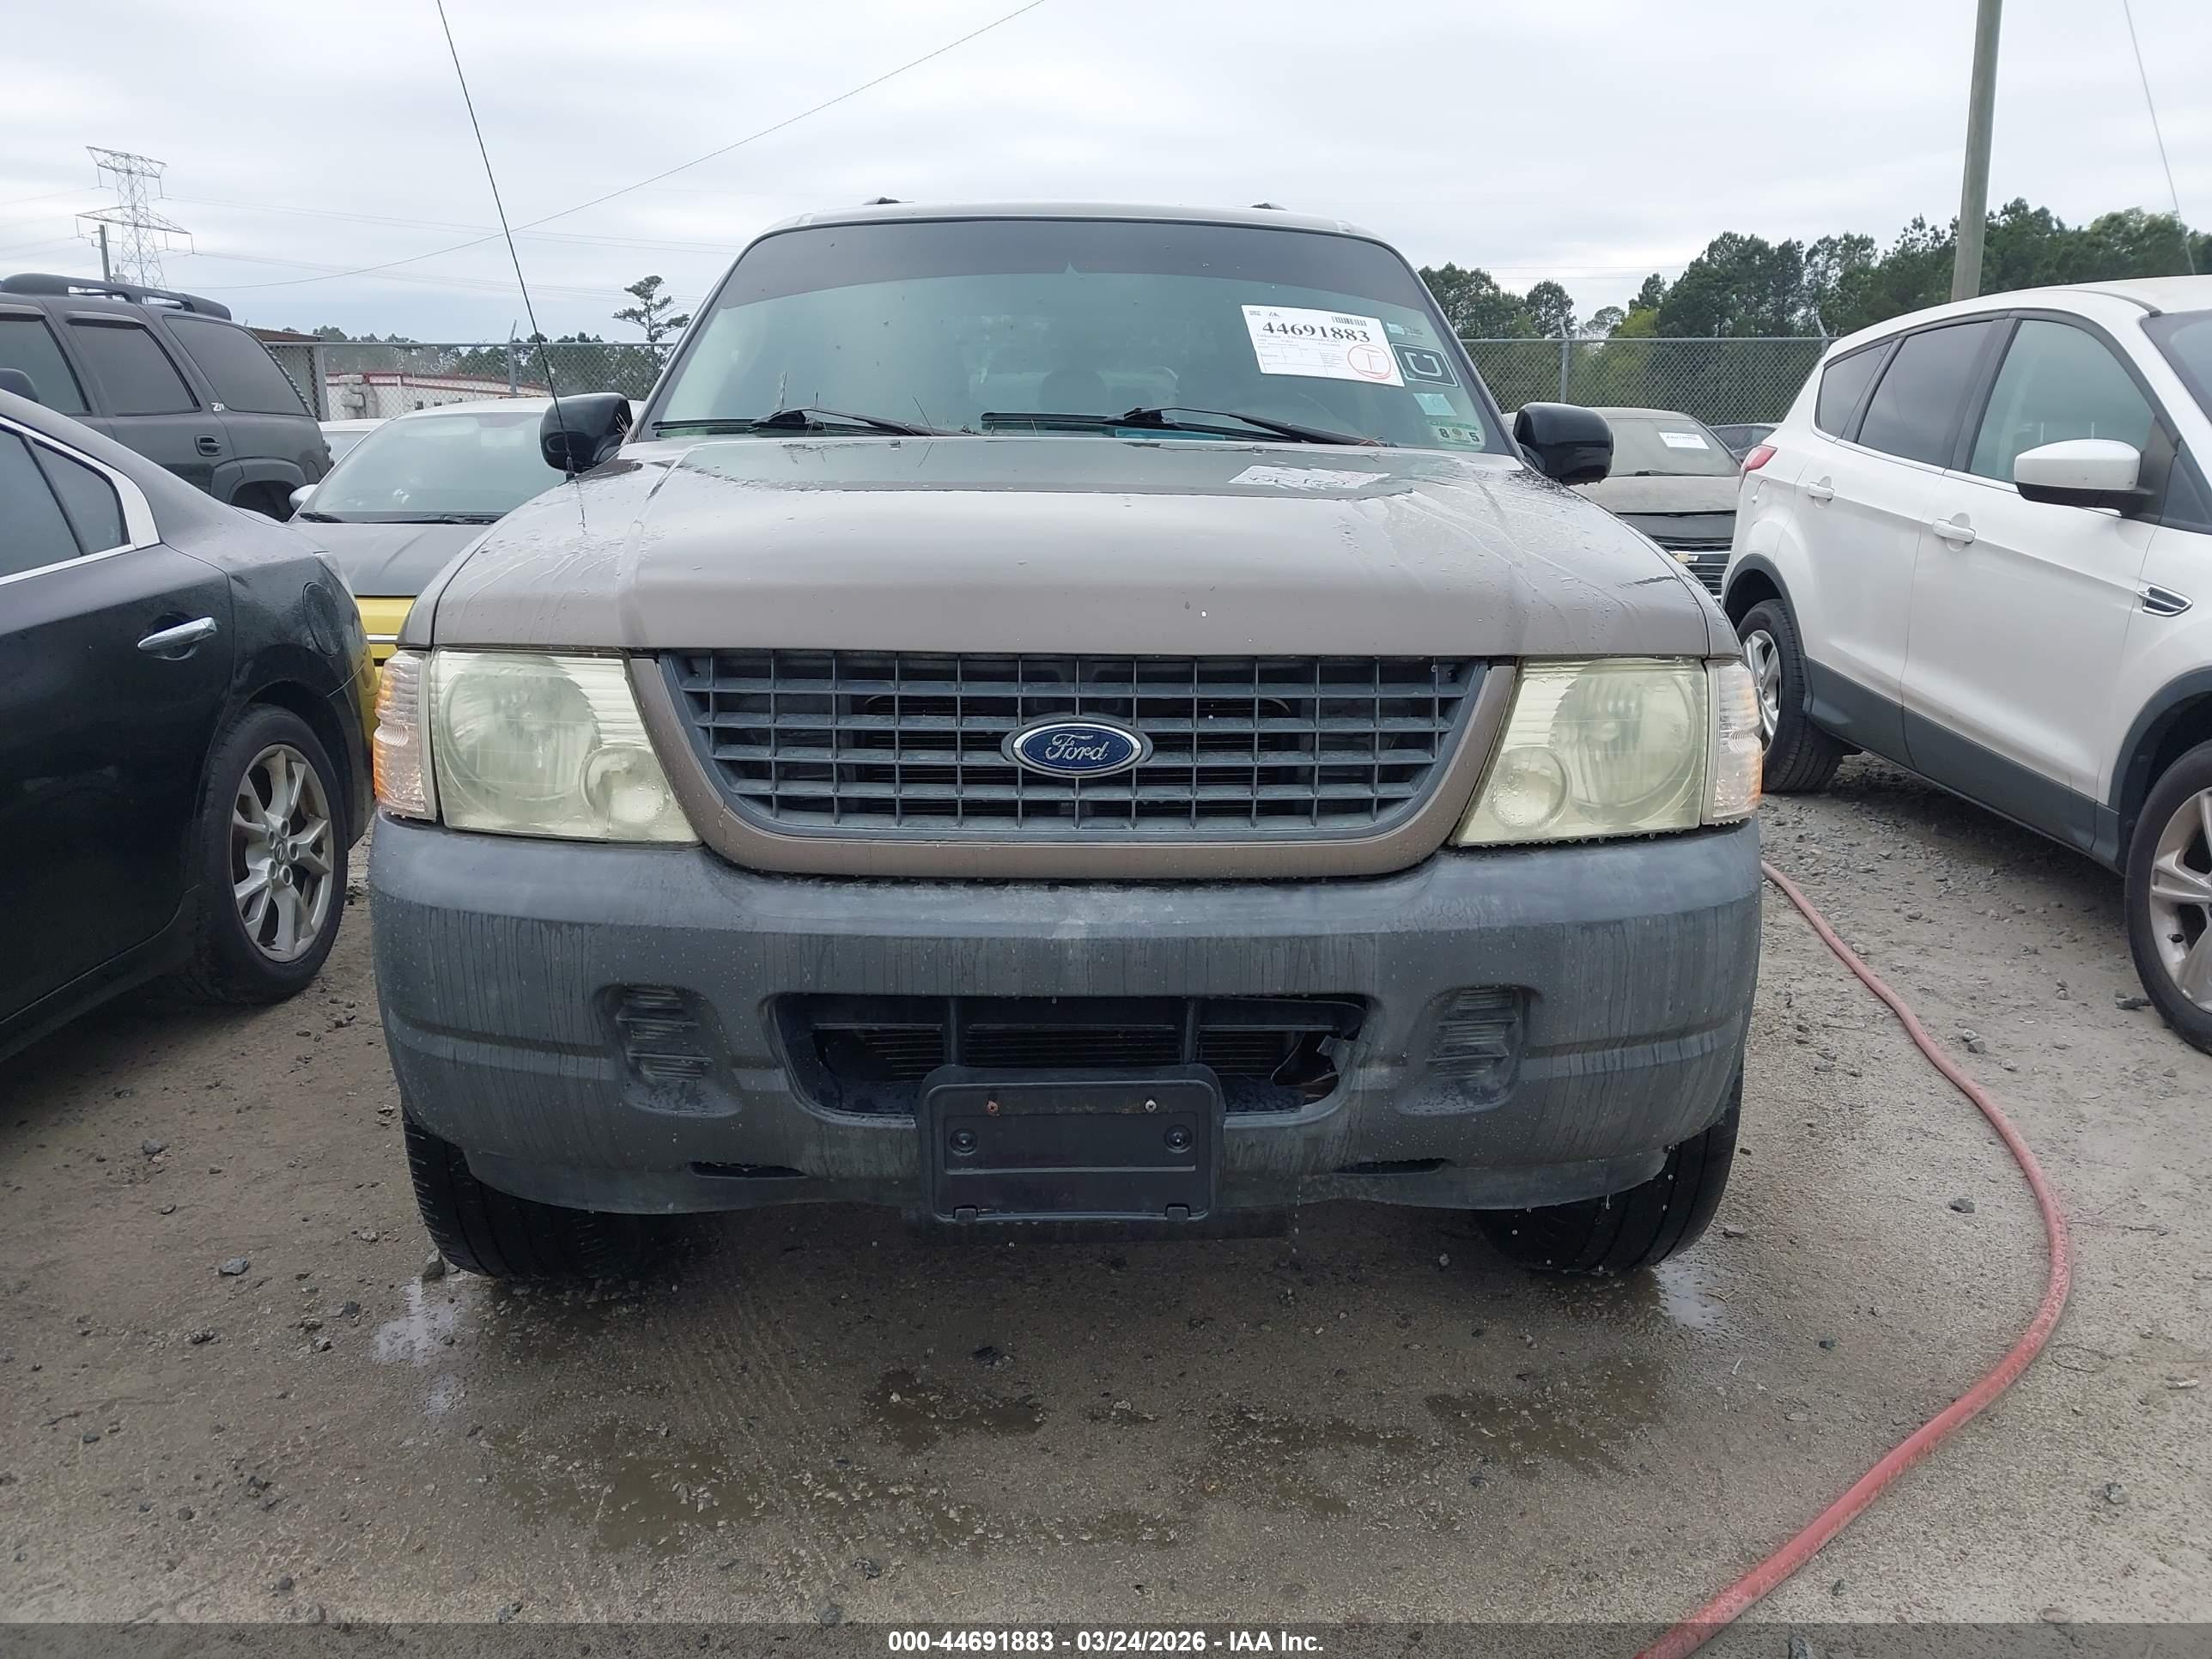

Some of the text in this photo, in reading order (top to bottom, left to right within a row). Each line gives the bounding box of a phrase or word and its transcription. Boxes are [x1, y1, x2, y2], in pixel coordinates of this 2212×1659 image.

[1262, 321, 1371, 343] 44691883
[1468, 431, 1480, 443] 5
[1045, 732, 1109, 762] Ford
